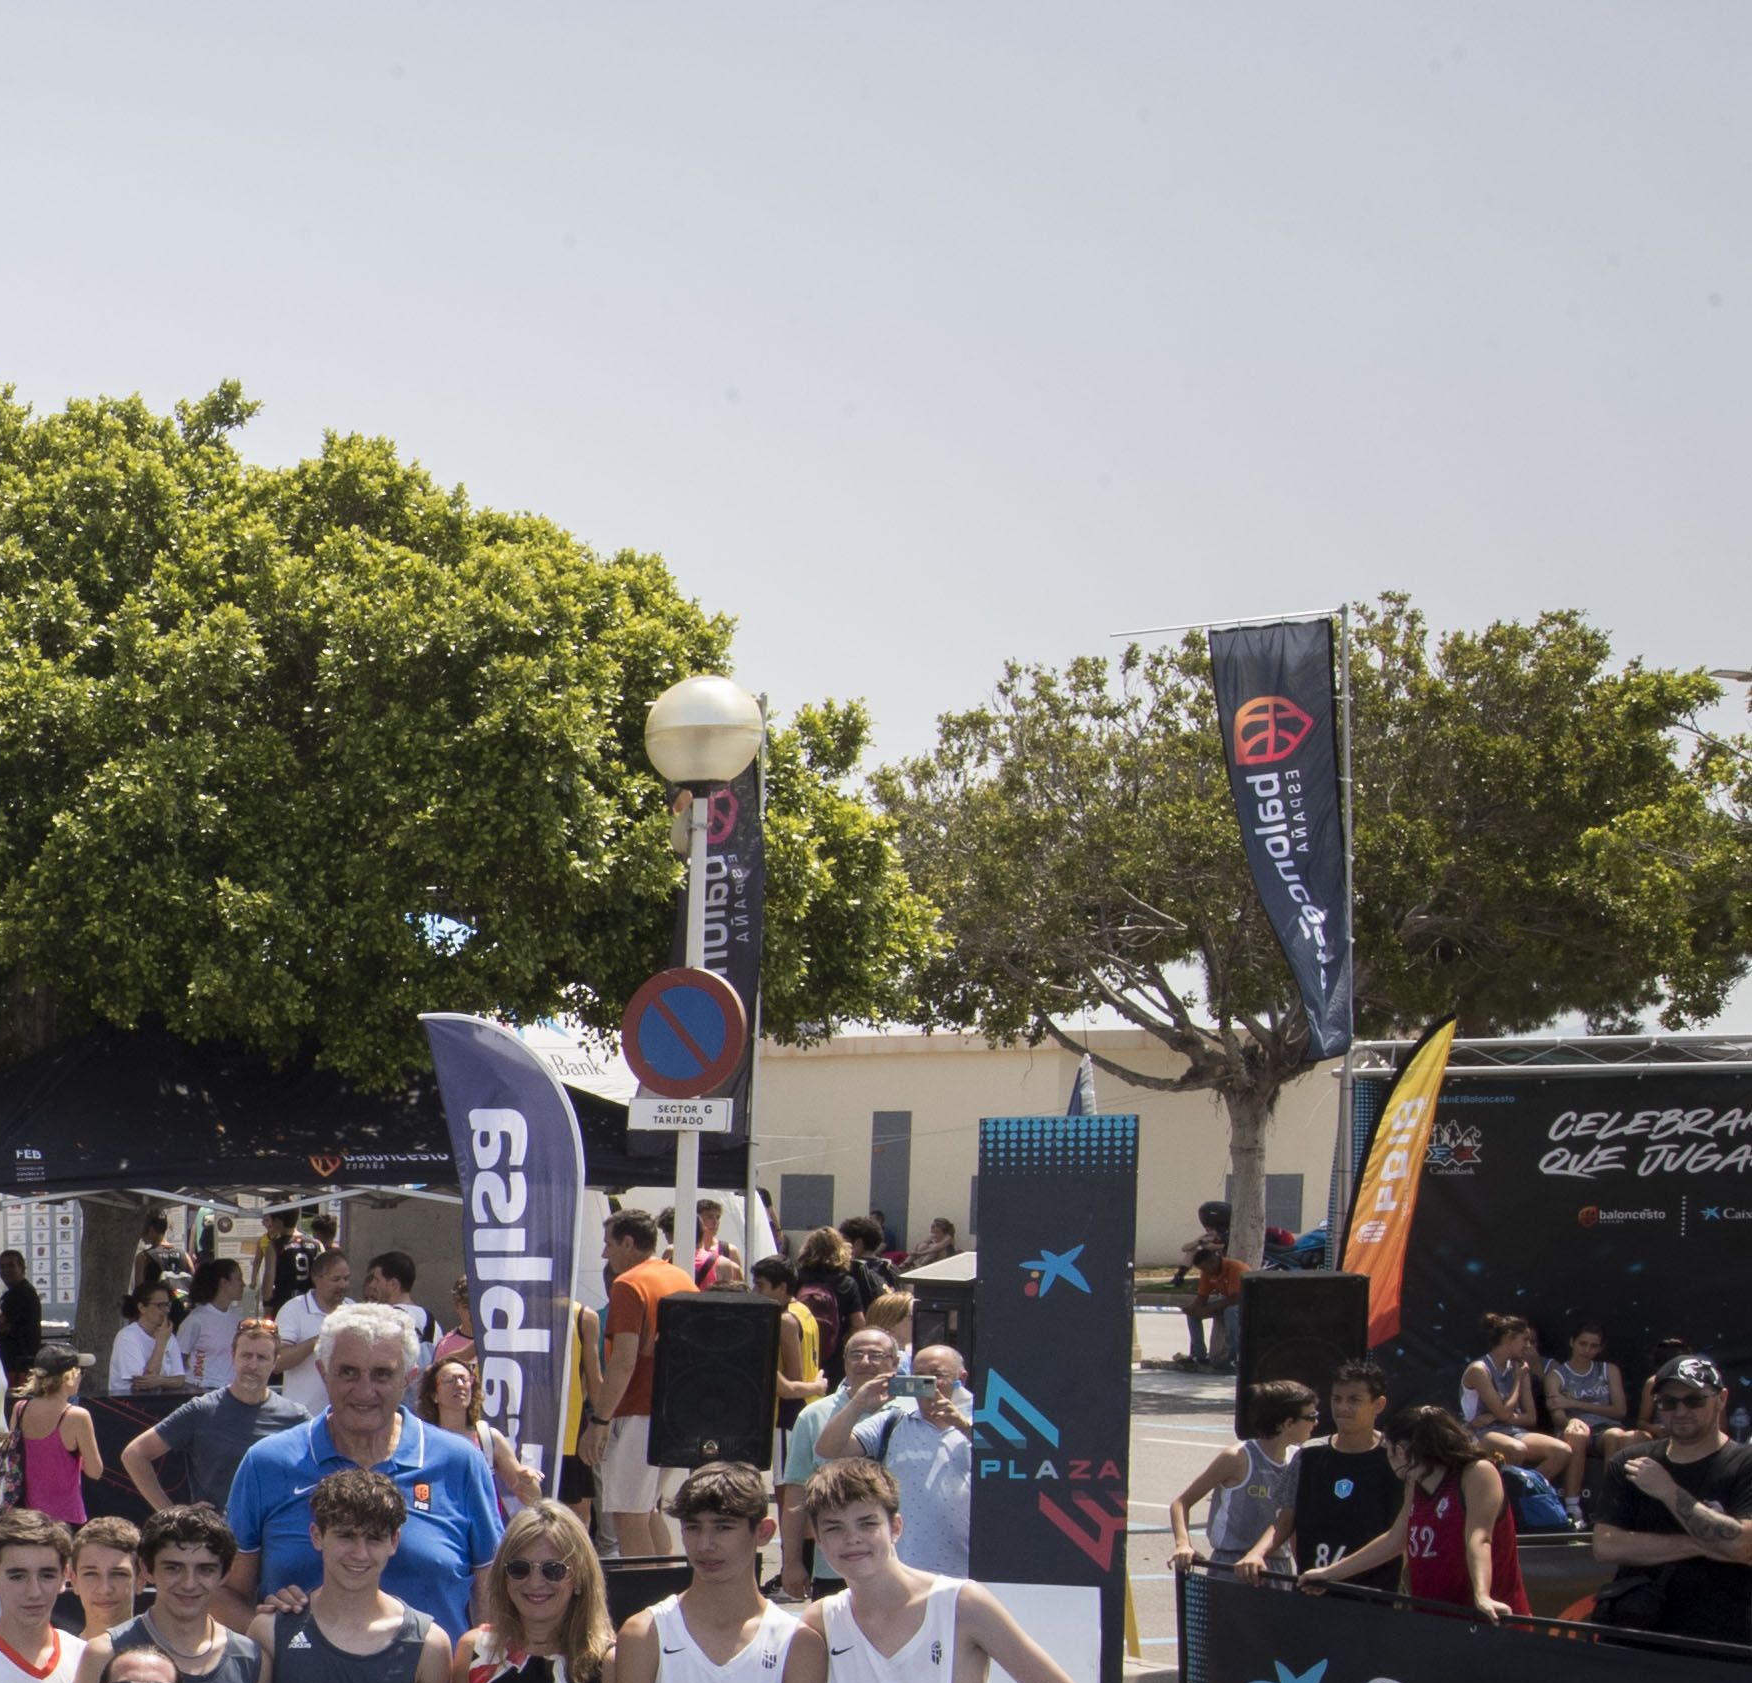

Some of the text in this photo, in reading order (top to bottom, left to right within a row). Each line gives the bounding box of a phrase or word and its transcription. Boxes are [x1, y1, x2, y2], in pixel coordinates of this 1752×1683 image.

[657, 1104, 713, 1114] SECTOR G
[652, 1115, 704, 1125] TARIFADO
[15, 1149, 42, 1160] FEB
[1377, 1095, 1428, 1212] FBIB
[1537, 1144, 1627, 1179] QUE
[1598, 1207, 1667, 1220] baloncesto
[979, 1458, 1121, 1481] PLAZA
[1408, 1525, 1438, 1558] 32
